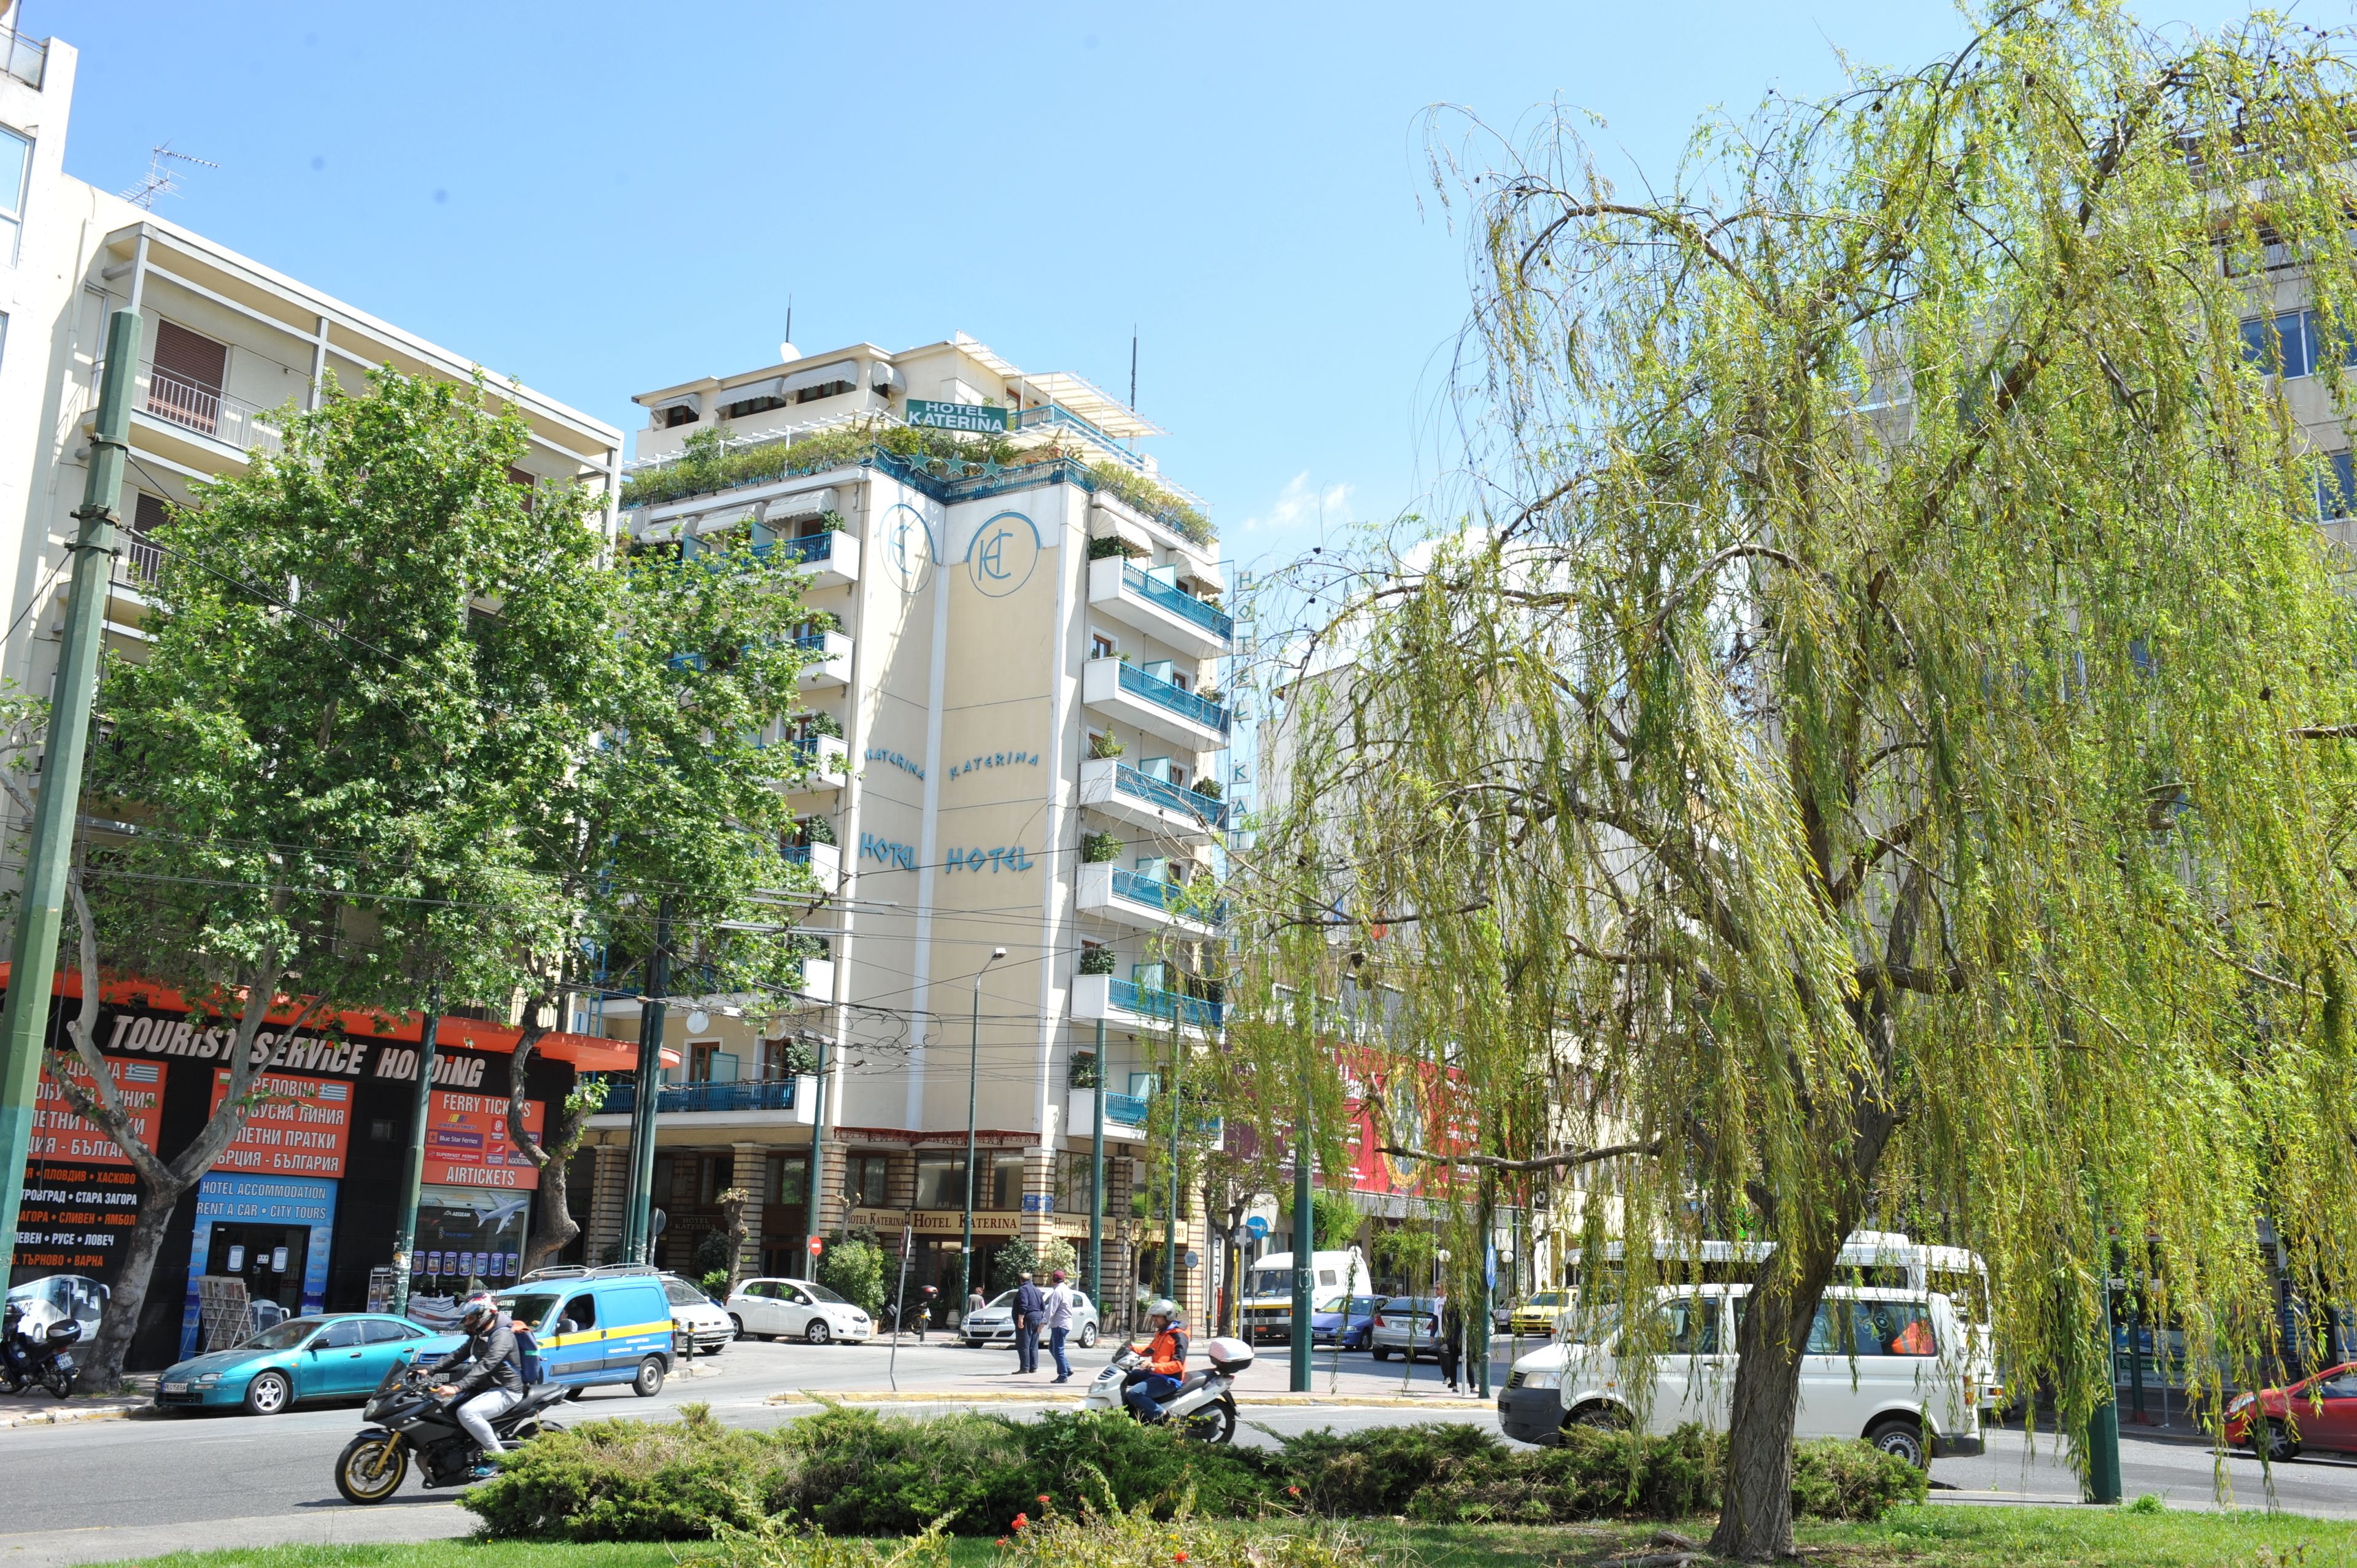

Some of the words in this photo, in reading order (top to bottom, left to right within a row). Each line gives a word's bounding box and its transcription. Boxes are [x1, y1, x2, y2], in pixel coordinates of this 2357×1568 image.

[926, 402, 988, 417] HOTEL
[908, 411, 1004, 432] KATERINA
[865, 747, 925, 781] KATERINA
[949, 751, 1039, 781] KATERINA
[859, 832, 919, 872] HOTEL
[945, 846, 1034, 874] HOTEL
[298, 1106, 344, 1125] ЛИНИЯ
[443, 1093, 481, 1113] FERRY
[484, 1098, 532, 1119] TICKS
[285, 1130, 336, 1149] ПРАТКИ
[217, 1149, 261, 1168] ЪРЦИЯ
[273, 1153, 339, 1172] БЪЛГАРИЯ
[44, 1168, 87, 1182] ПЛОВДИВ
[96, 1172, 136, 1185] ХАСКОВО
[446, 1166, 516, 1186] AIRTICKETS
[75, 1191, 103, 1204] СТАРА
[105, 1193, 137, 1206] ЗАГОРА
[202, 1181, 234, 1195] HOTEL
[237, 1183, 327, 1200] ACCOMMODATION
[59, 1213, 95, 1224] СЛИВЕН
[104, 1214, 137, 1226] ЯМБОЛ
[196, 1202, 225, 1215] RENT
[226, 1203, 233, 1216] A
[238, 1203, 258, 1217] CAR
[270, 1205, 292, 1218] CITY
[295, 1206, 327, 1220] TOURS
[870, 1212, 905, 1227] KATERINA
[913, 1213, 951, 1228] HOTEL
[1055, 1218, 1077, 1231] HOTEL
[15, 1232, 42, 1245] ЛЕВЕН
[52, 1233, 75, 1245] РУСЕ
[84, 1235, 115, 1246] ЛОВЕЧ
[23, 1254, 64, 1266] ТЪРНОВО
[74, 1256, 103, 1267] ВАРНА
